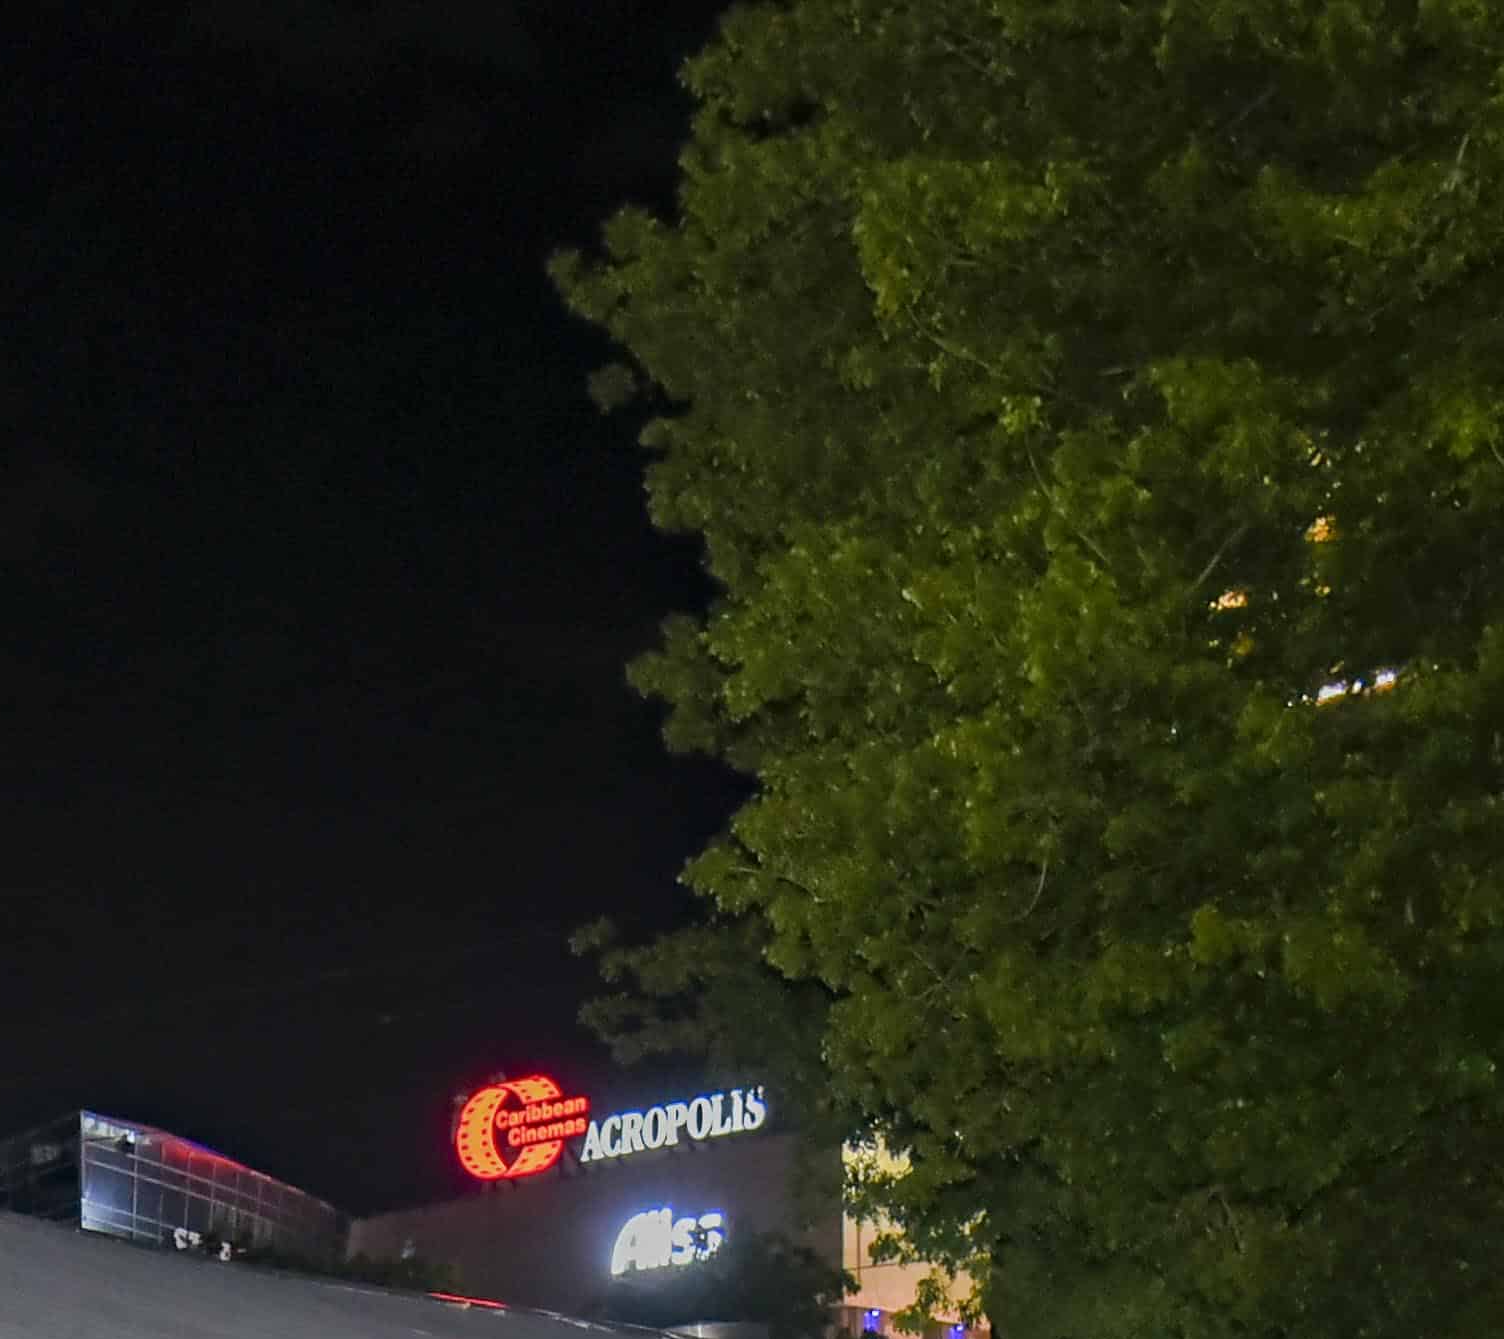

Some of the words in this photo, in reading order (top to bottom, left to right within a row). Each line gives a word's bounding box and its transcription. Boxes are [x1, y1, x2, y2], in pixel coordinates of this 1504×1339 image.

[495, 1097, 587, 1130] Caribbean
[580, 1085, 766, 1162] ACROPOLIS
[508, 1117, 587, 1148] Cinemas
